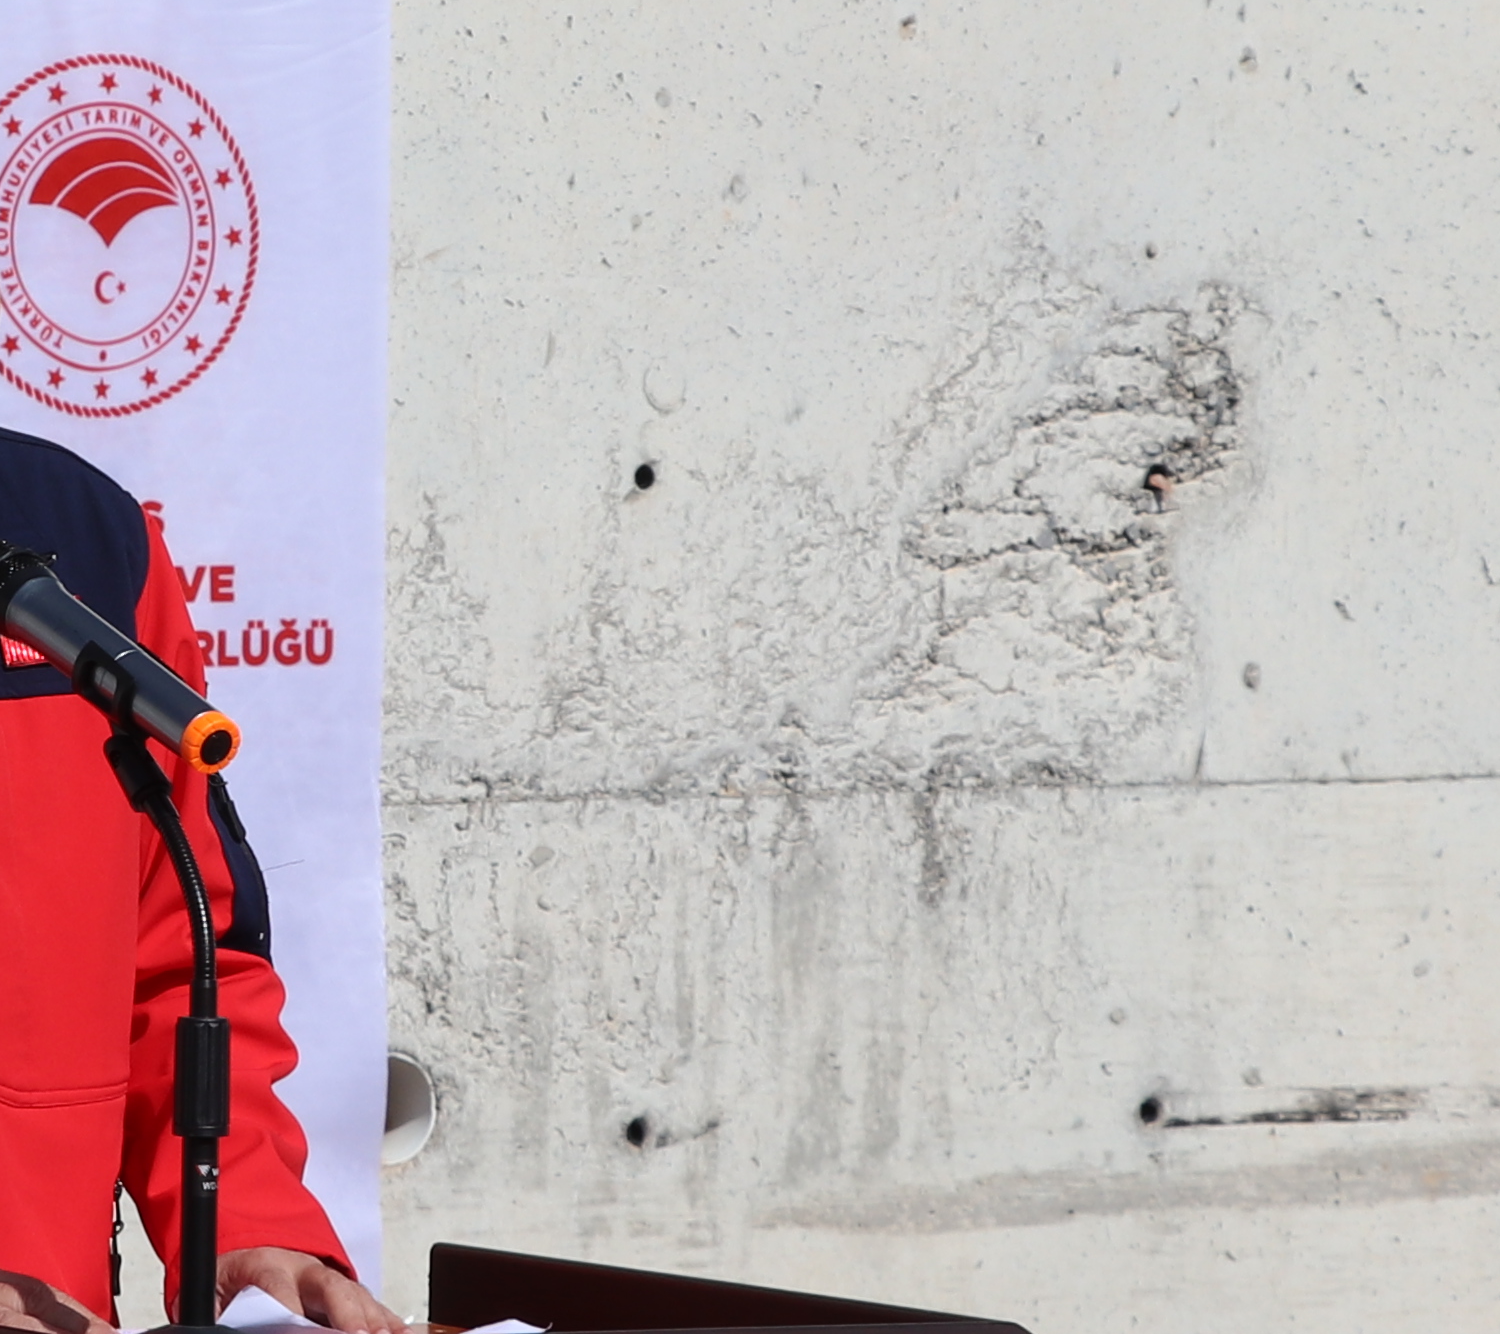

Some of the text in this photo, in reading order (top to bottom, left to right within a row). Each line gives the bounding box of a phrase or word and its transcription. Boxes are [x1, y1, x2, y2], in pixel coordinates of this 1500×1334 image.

[82, 109, 143, 129] TARIM
[149, 124, 170, 147] VE
[173, 150, 209, 226] ORMAN
[1, 268, 64, 349] TÜRKİYE
[142, 240, 209, 349] BAKANLIĞI
[194, 619, 334, 667] RLÜĞÜ
